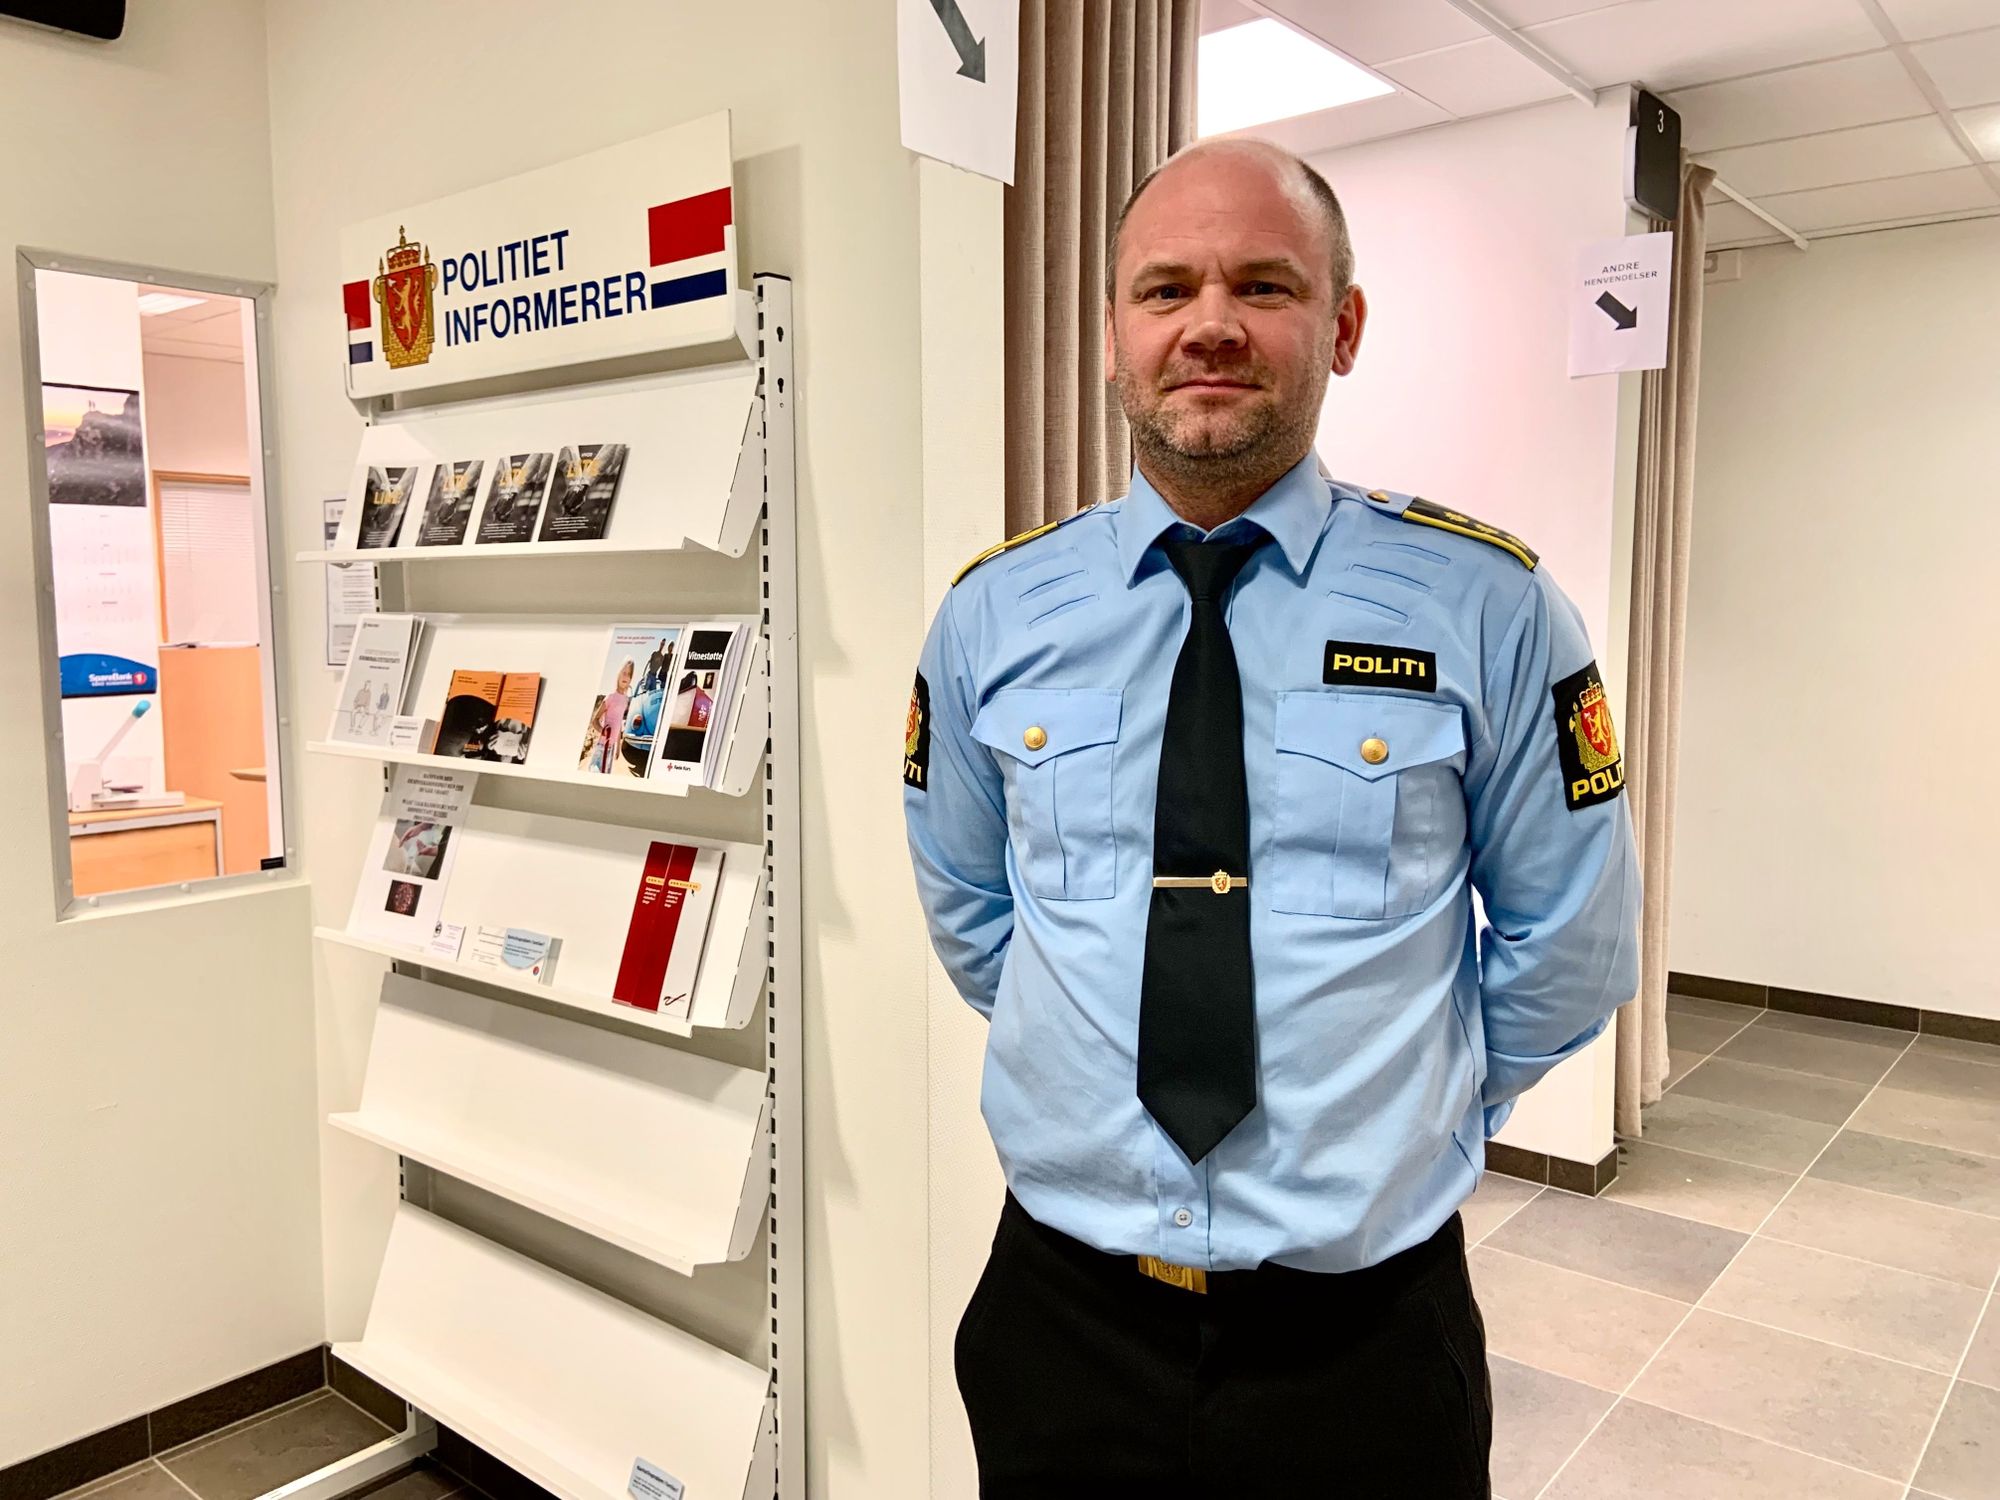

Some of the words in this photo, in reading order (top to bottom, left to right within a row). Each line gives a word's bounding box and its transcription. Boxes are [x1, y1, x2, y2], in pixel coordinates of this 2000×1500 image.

[1657, 109, 1664, 133] 3
[442, 229, 569, 296] POLITIET
[1602, 261, 1640, 274] ANDRE
[1584, 270, 1658, 287] HENVENDELSER
[445, 271, 647, 347] INFORMERER
[688, 651, 723, 661] Vitnestøtte
[1333, 653, 1426, 678] POLITI
